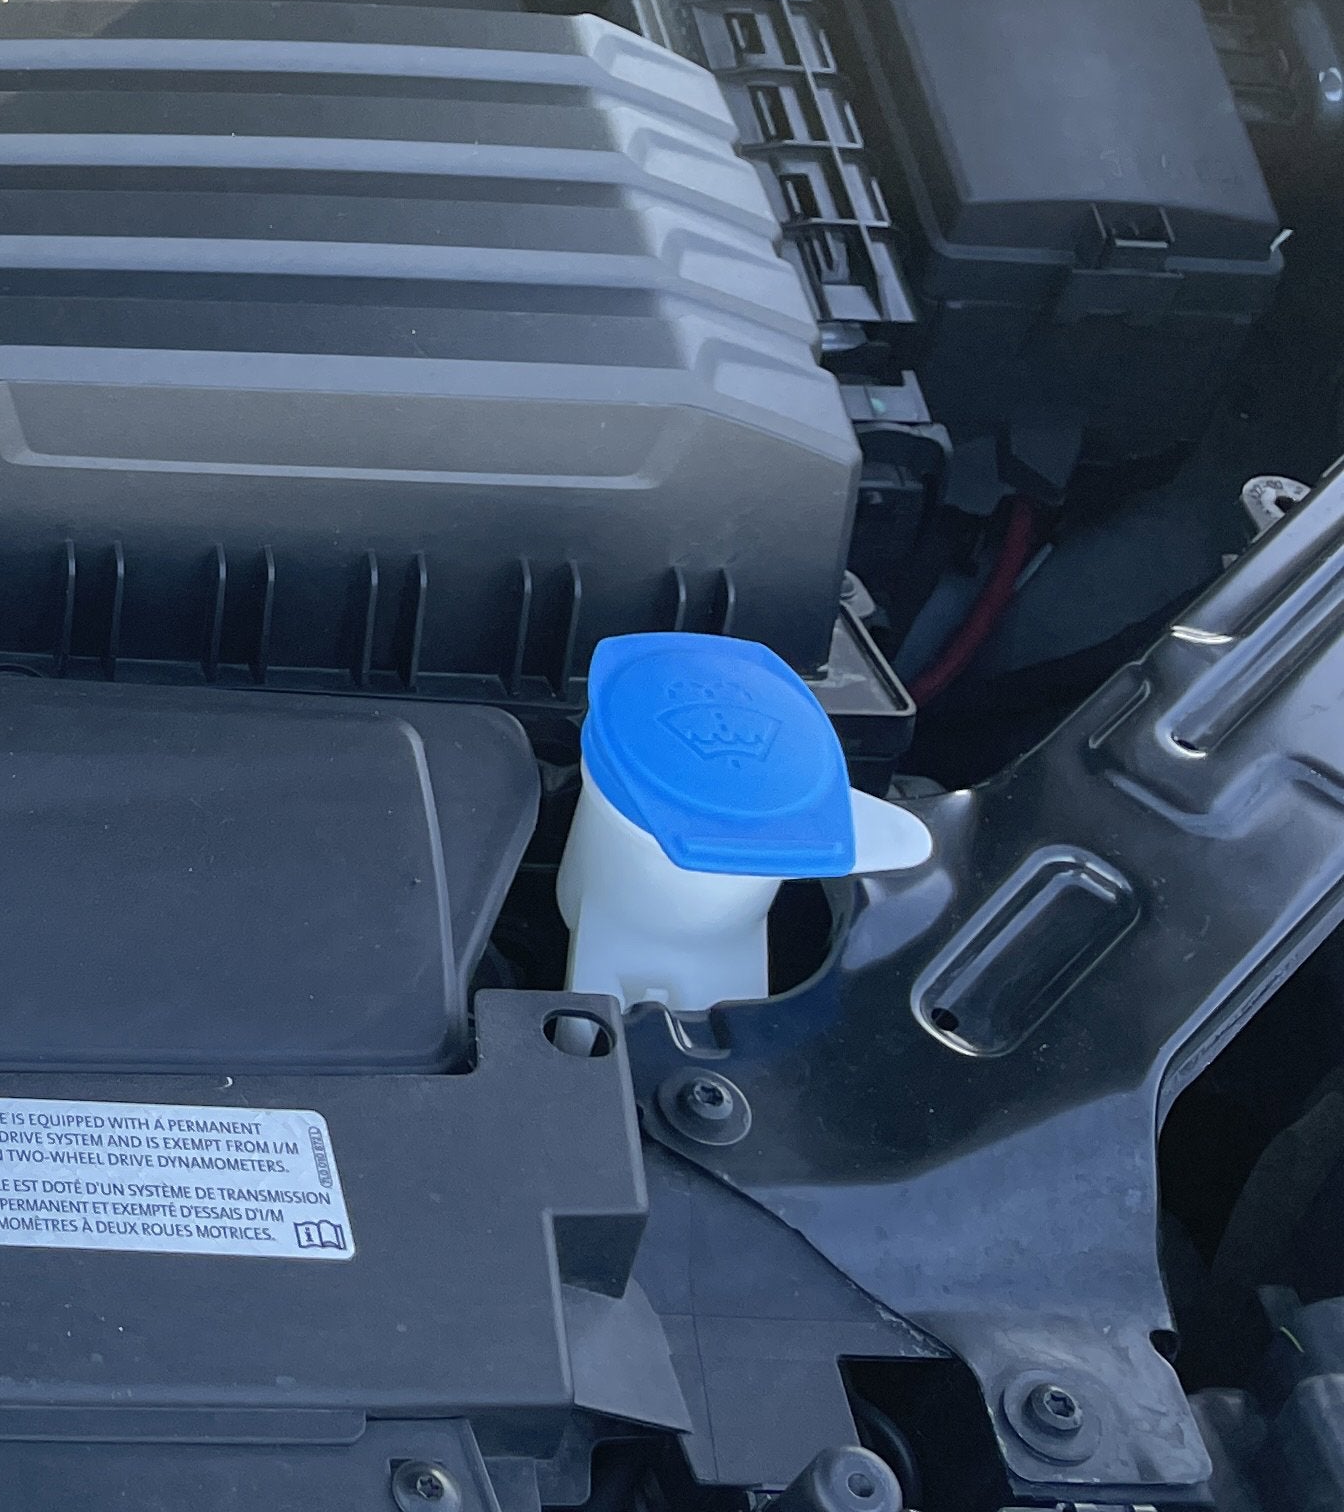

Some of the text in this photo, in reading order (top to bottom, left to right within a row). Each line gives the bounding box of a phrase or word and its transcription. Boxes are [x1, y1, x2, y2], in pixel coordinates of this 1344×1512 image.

[11, 1112, 24, 1125] IS
[28, 1113, 104, 1128] EQUIPPED
[107, 1116, 150, 1130] WITH
[153, 1116, 165, 1131] A
[167, 1118, 261, 1135] PERMANENT
[46, 1132, 103, 1146] SYSTEM
[107, 1134, 142, 1148] AND
[145, 1136, 160, 1148] IS
[162, 1136, 221, 1151] EXEMPT
[225, 1139, 270, 1153] FROM
[272, 1141, 299, 1154] I/M
[5, 1148, 105, 1165] TWO-WHEEL
[107, 1152, 154, 1167] DRIVE
[156, 1154, 289, 1172] DYNAMOMETERS.
[12, 1178, 38, 1192] EST
[41, 1178, 82, 1194] DOTÉ
[85, 1181, 124, 1196] D'UN
[127, 1183, 192, 1199] SYSTÈME
[194, 1186, 215, 1200] DE
[216, 1187, 330, 1205] TRANSMISSION
[0, 1197, 88, 1213] PERMANENT
[91, 1201, 108, 1214] ET
[111, 1201, 177, 1217] EXEMPTÉ
[179, 1204, 242, 1220] D'ESSAIS
[244, 1207, 284, 1222] D'I/M
[81, 1216, 93, 1232] À
[95, 1220, 139, 1235] DEUX
[141, 1222, 193, 1237] ROUES
[194, 1224, 275, 1240] MOTRICES.
